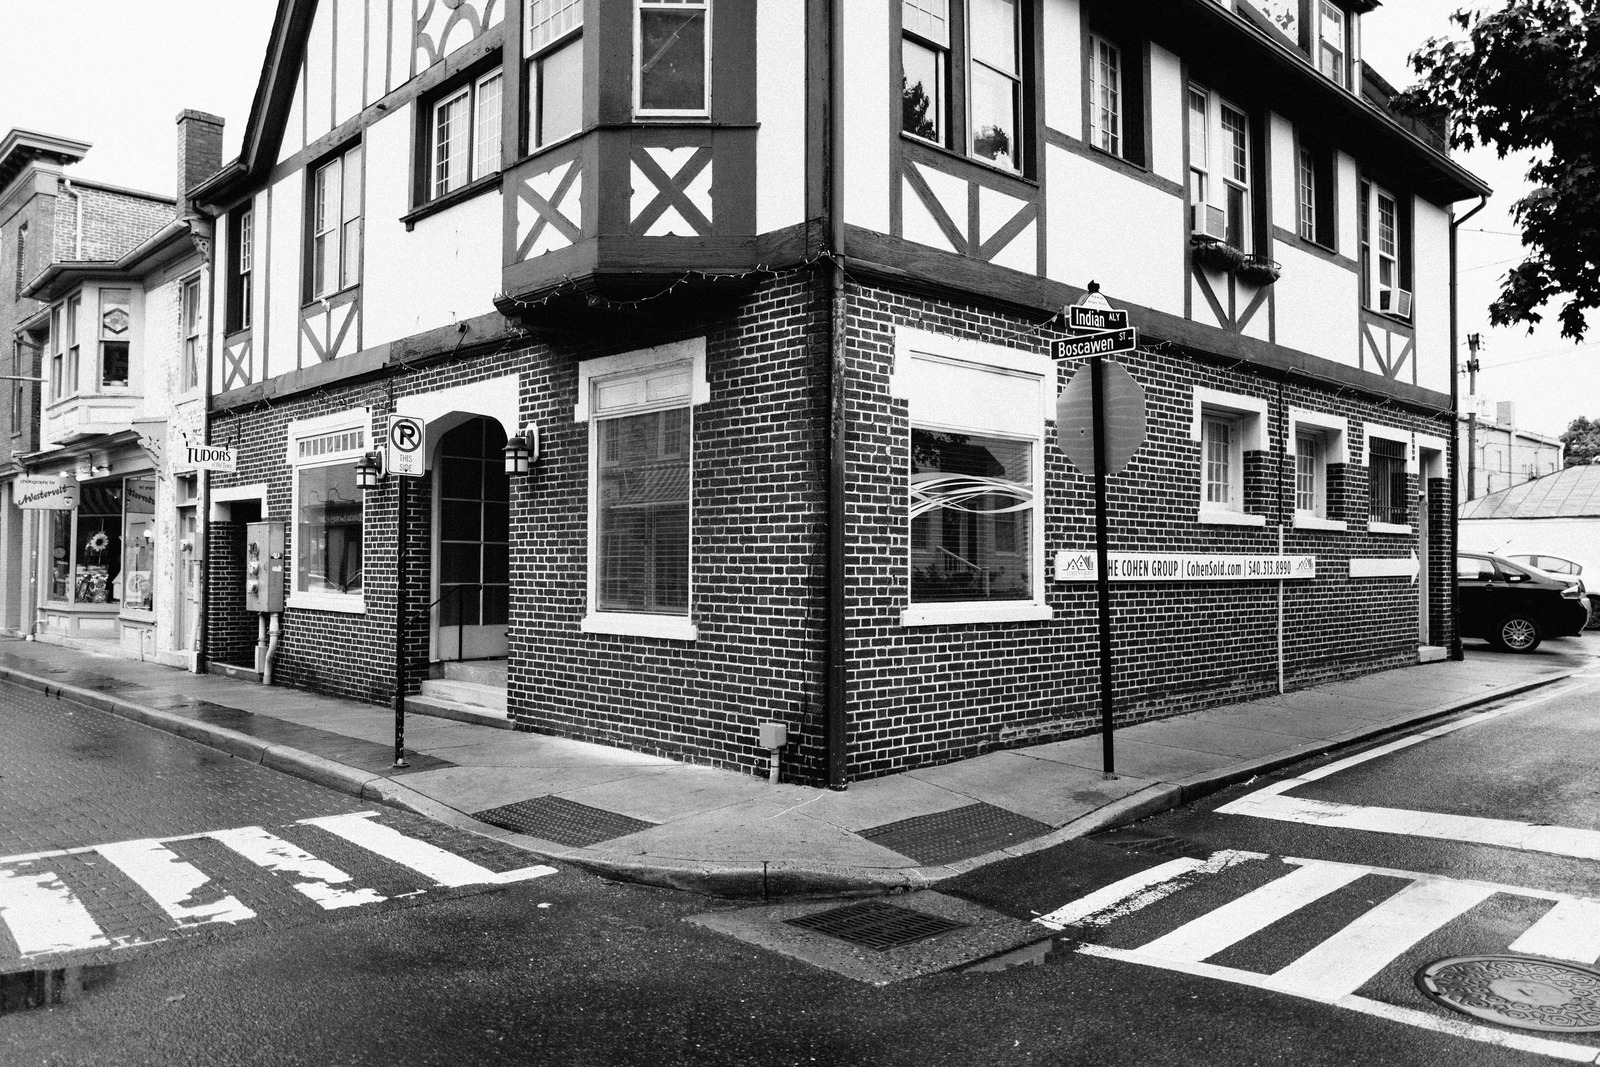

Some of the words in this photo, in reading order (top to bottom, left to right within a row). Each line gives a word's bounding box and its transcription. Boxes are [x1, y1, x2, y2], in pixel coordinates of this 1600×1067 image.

[1075, 308, 1105, 328] Indian
[1108, 312, 1121, 322] ALY
[1058, 337, 1114, 358] Boscawen
[1118, 331, 1127, 341] ST
[186, 447, 232, 464] TUDORS
[399, 454, 413, 463] THIS
[399, 463, 413, 472] SIDE
[1107, 559, 1119, 577] HE
[1121, 559, 1149, 577] COHEN
[1151, 559, 1179, 577] GROUP
[1186, 560, 1242, 577] CohenSold.com
[1248, 560, 1292, 576] 540.313.8990
